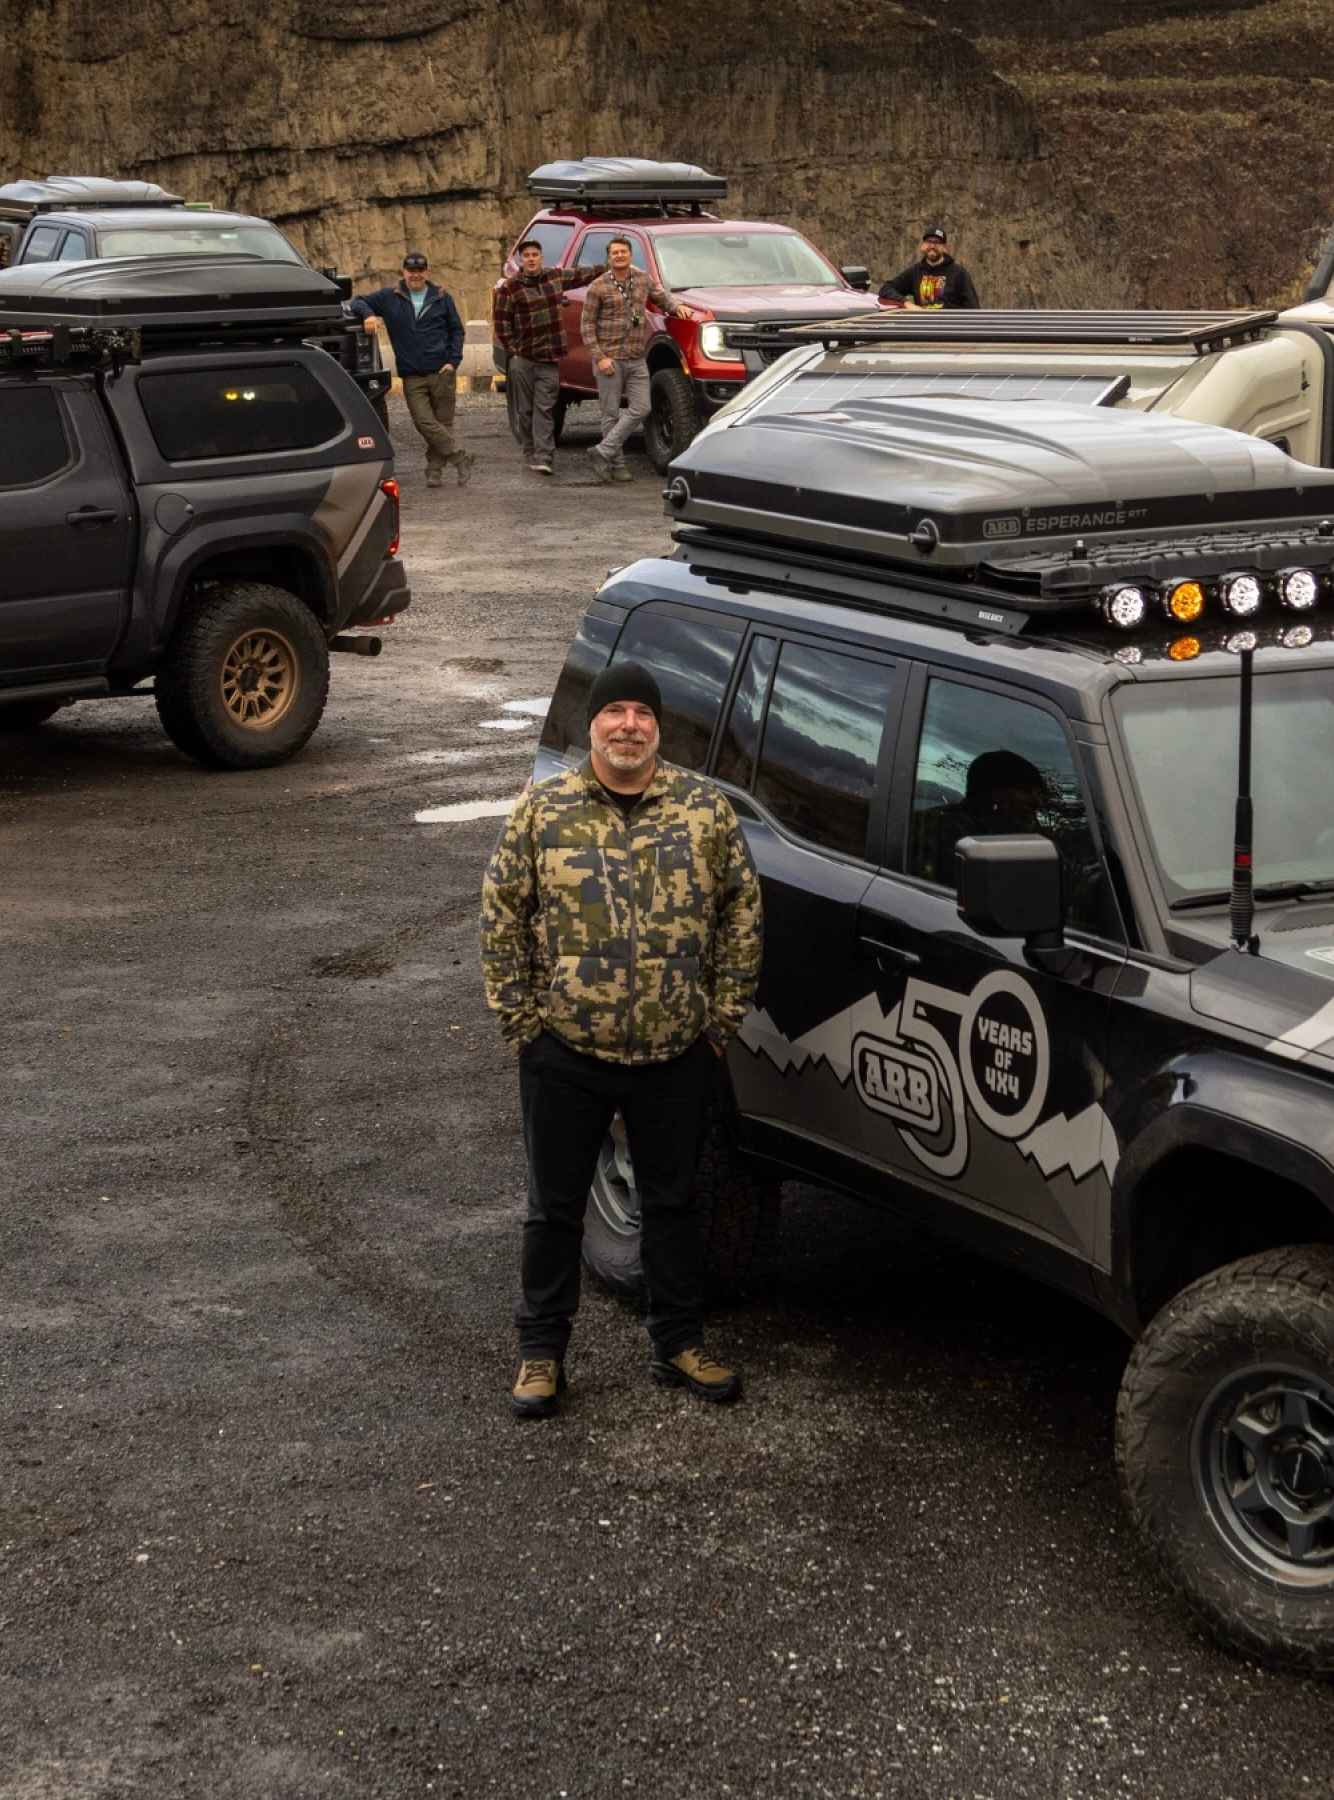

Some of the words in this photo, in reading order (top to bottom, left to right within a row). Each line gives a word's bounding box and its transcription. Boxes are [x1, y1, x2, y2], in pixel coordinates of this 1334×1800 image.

[986, 519, 1019, 536] ARB
[1026, 511, 1126, 532] ESPERANCE
[1128, 509, 1148, 518] RTT
[978, 1016, 1033, 1056] YEARS
[899, 970, 1050, 1182] 50
[995, 1048, 1013, 1070] OF
[865, 1052, 933, 1119] ARB
[985, 1065, 1020, 1100] 4X4
